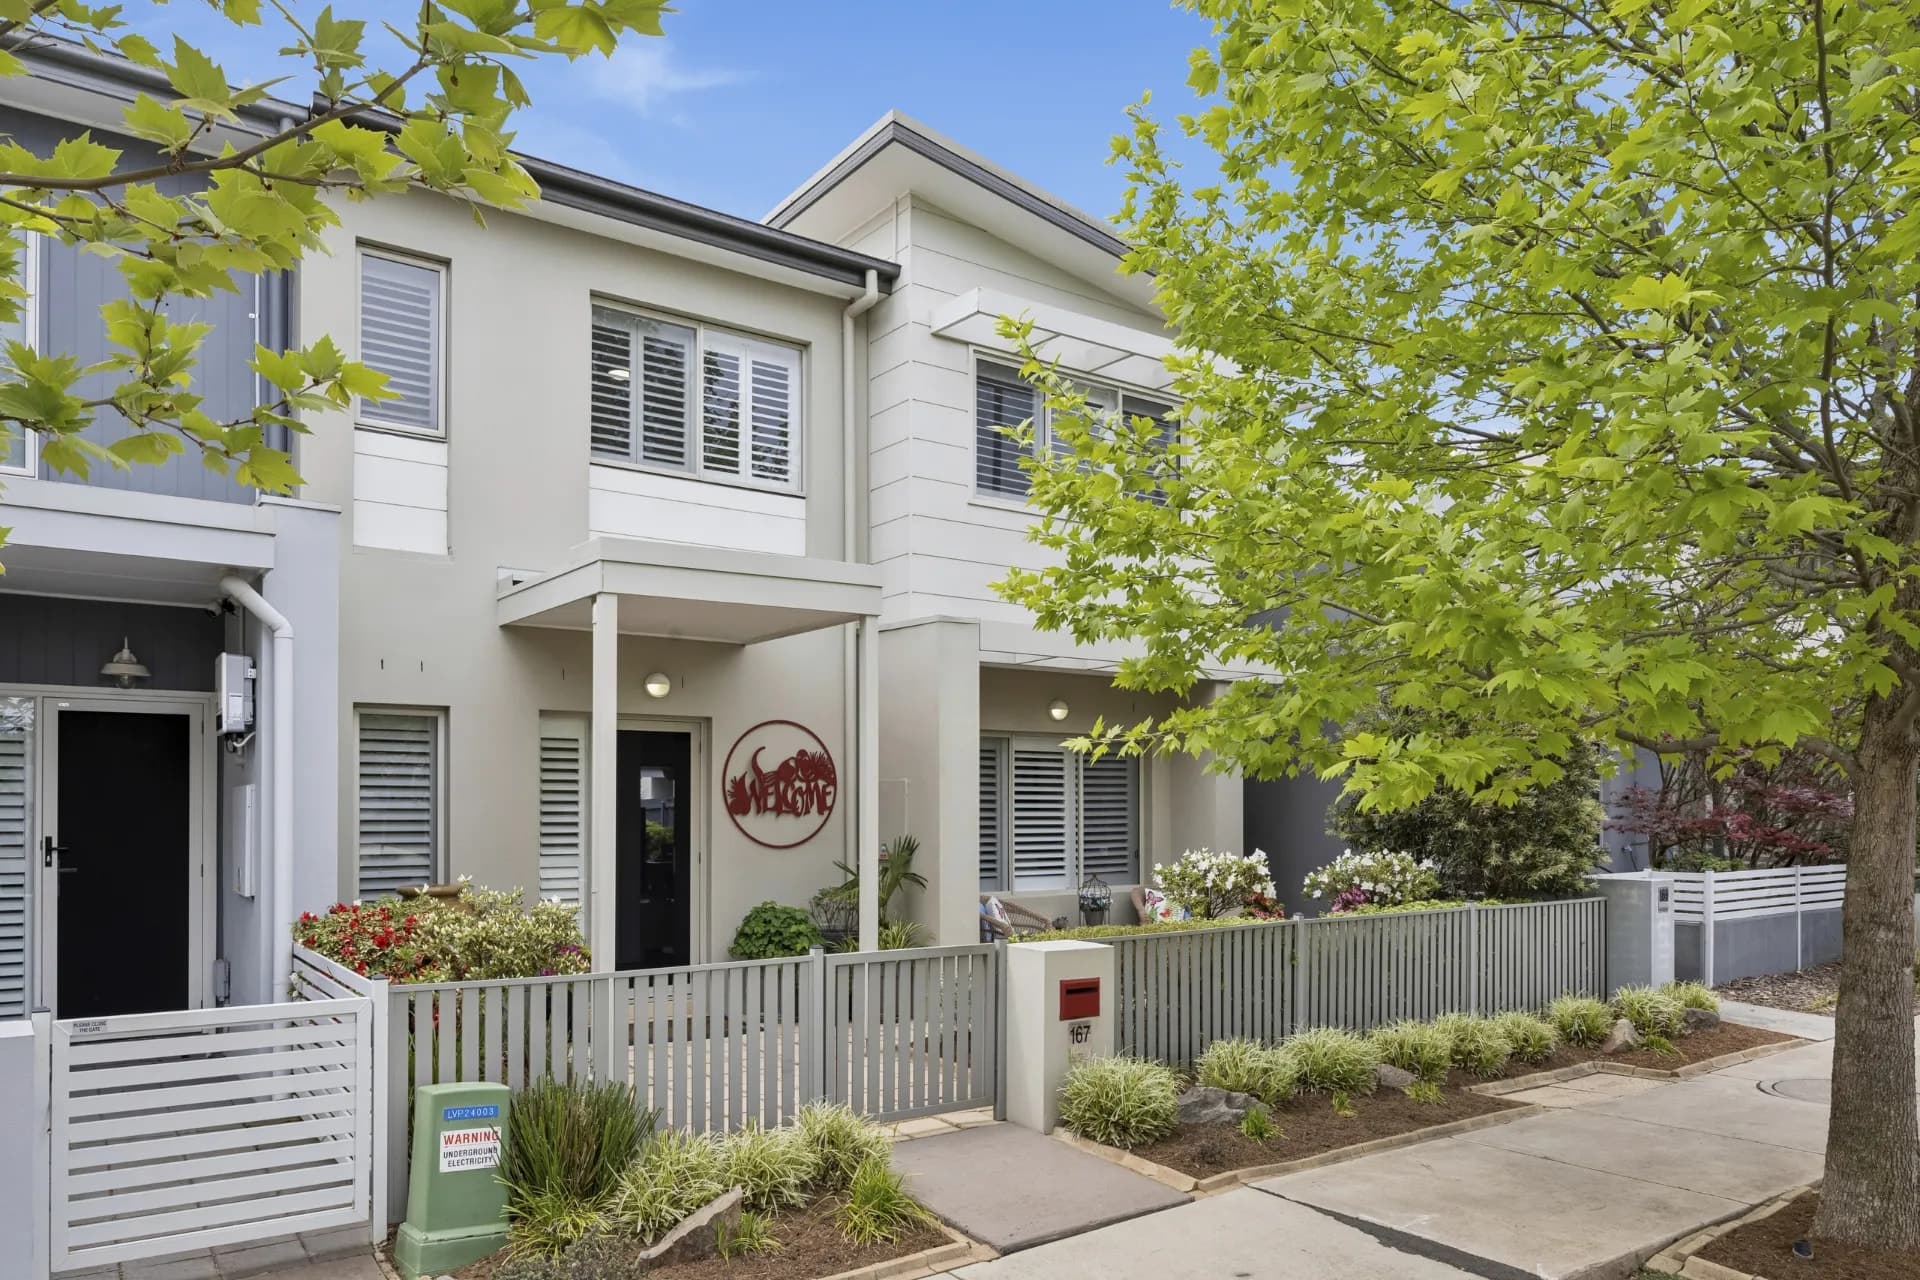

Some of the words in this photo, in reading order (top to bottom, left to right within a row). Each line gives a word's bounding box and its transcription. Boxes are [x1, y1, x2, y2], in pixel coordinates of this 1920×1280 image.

[733, 776, 833, 817] WELCOME
[1070, 1025, 1091, 1044] 167
[444, 1130, 499, 1145] WARNING
[443, 1145, 498, 1159] UNDERGROUND
[447, 1156, 492, 1168] ELECTRICITY
